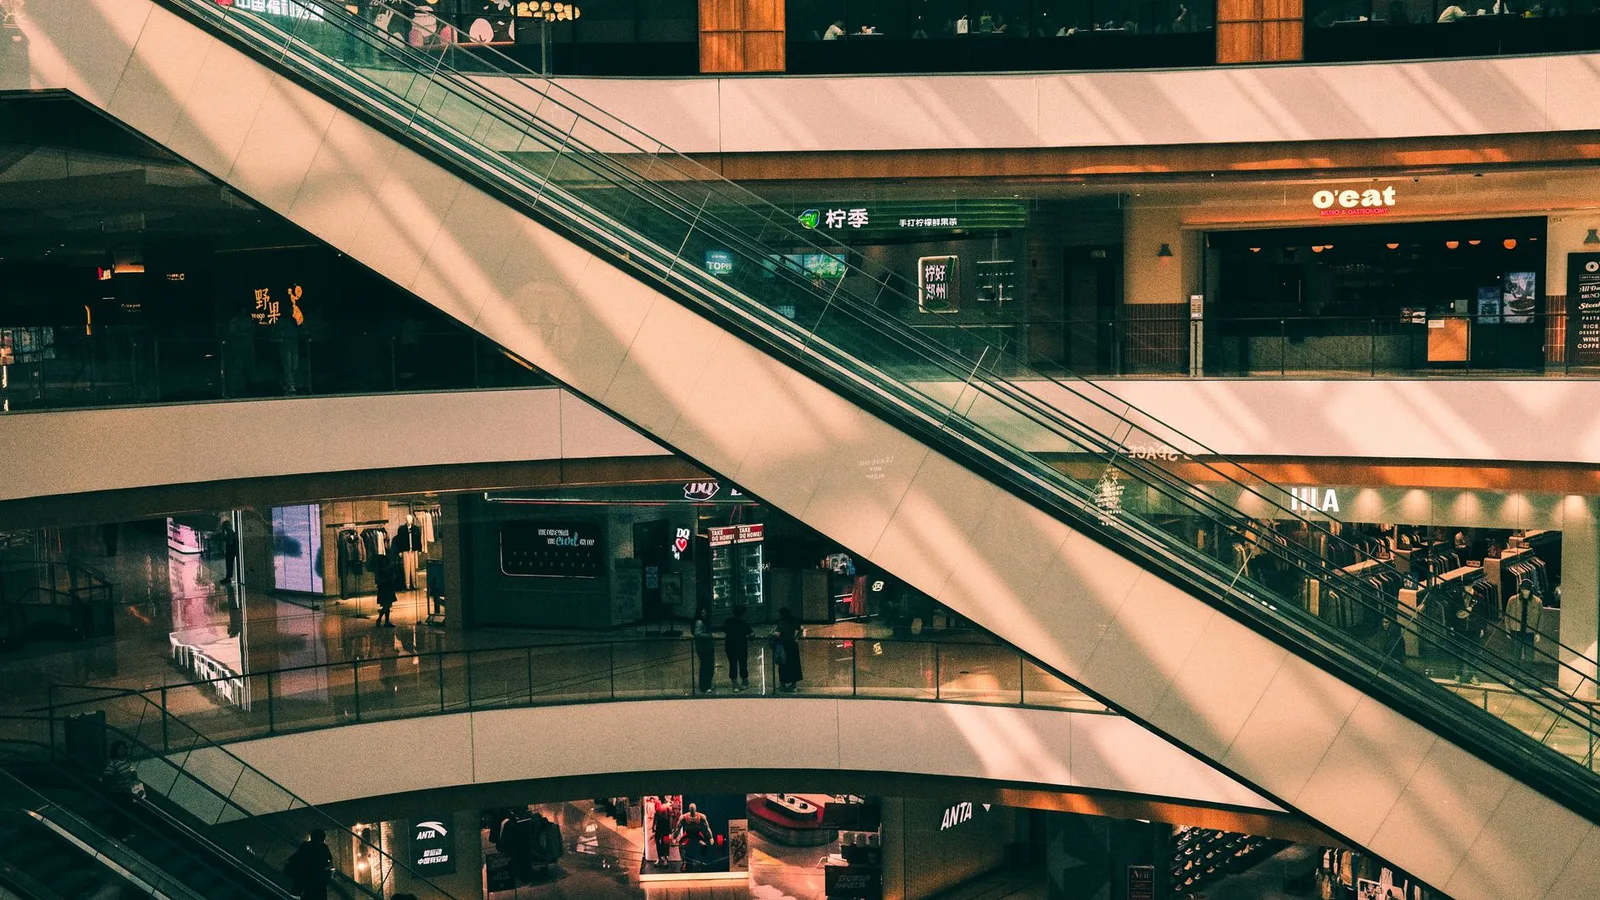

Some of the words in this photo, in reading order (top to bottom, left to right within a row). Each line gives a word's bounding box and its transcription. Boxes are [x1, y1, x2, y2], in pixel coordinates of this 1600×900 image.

[1312, 186, 1396, 209] o'eat
[825, 208, 869, 229] 柠季
[676, 528, 690, 540] DQ
[940, 802, 972, 831] ANTA
[416, 830, 435, 840] ANTA
